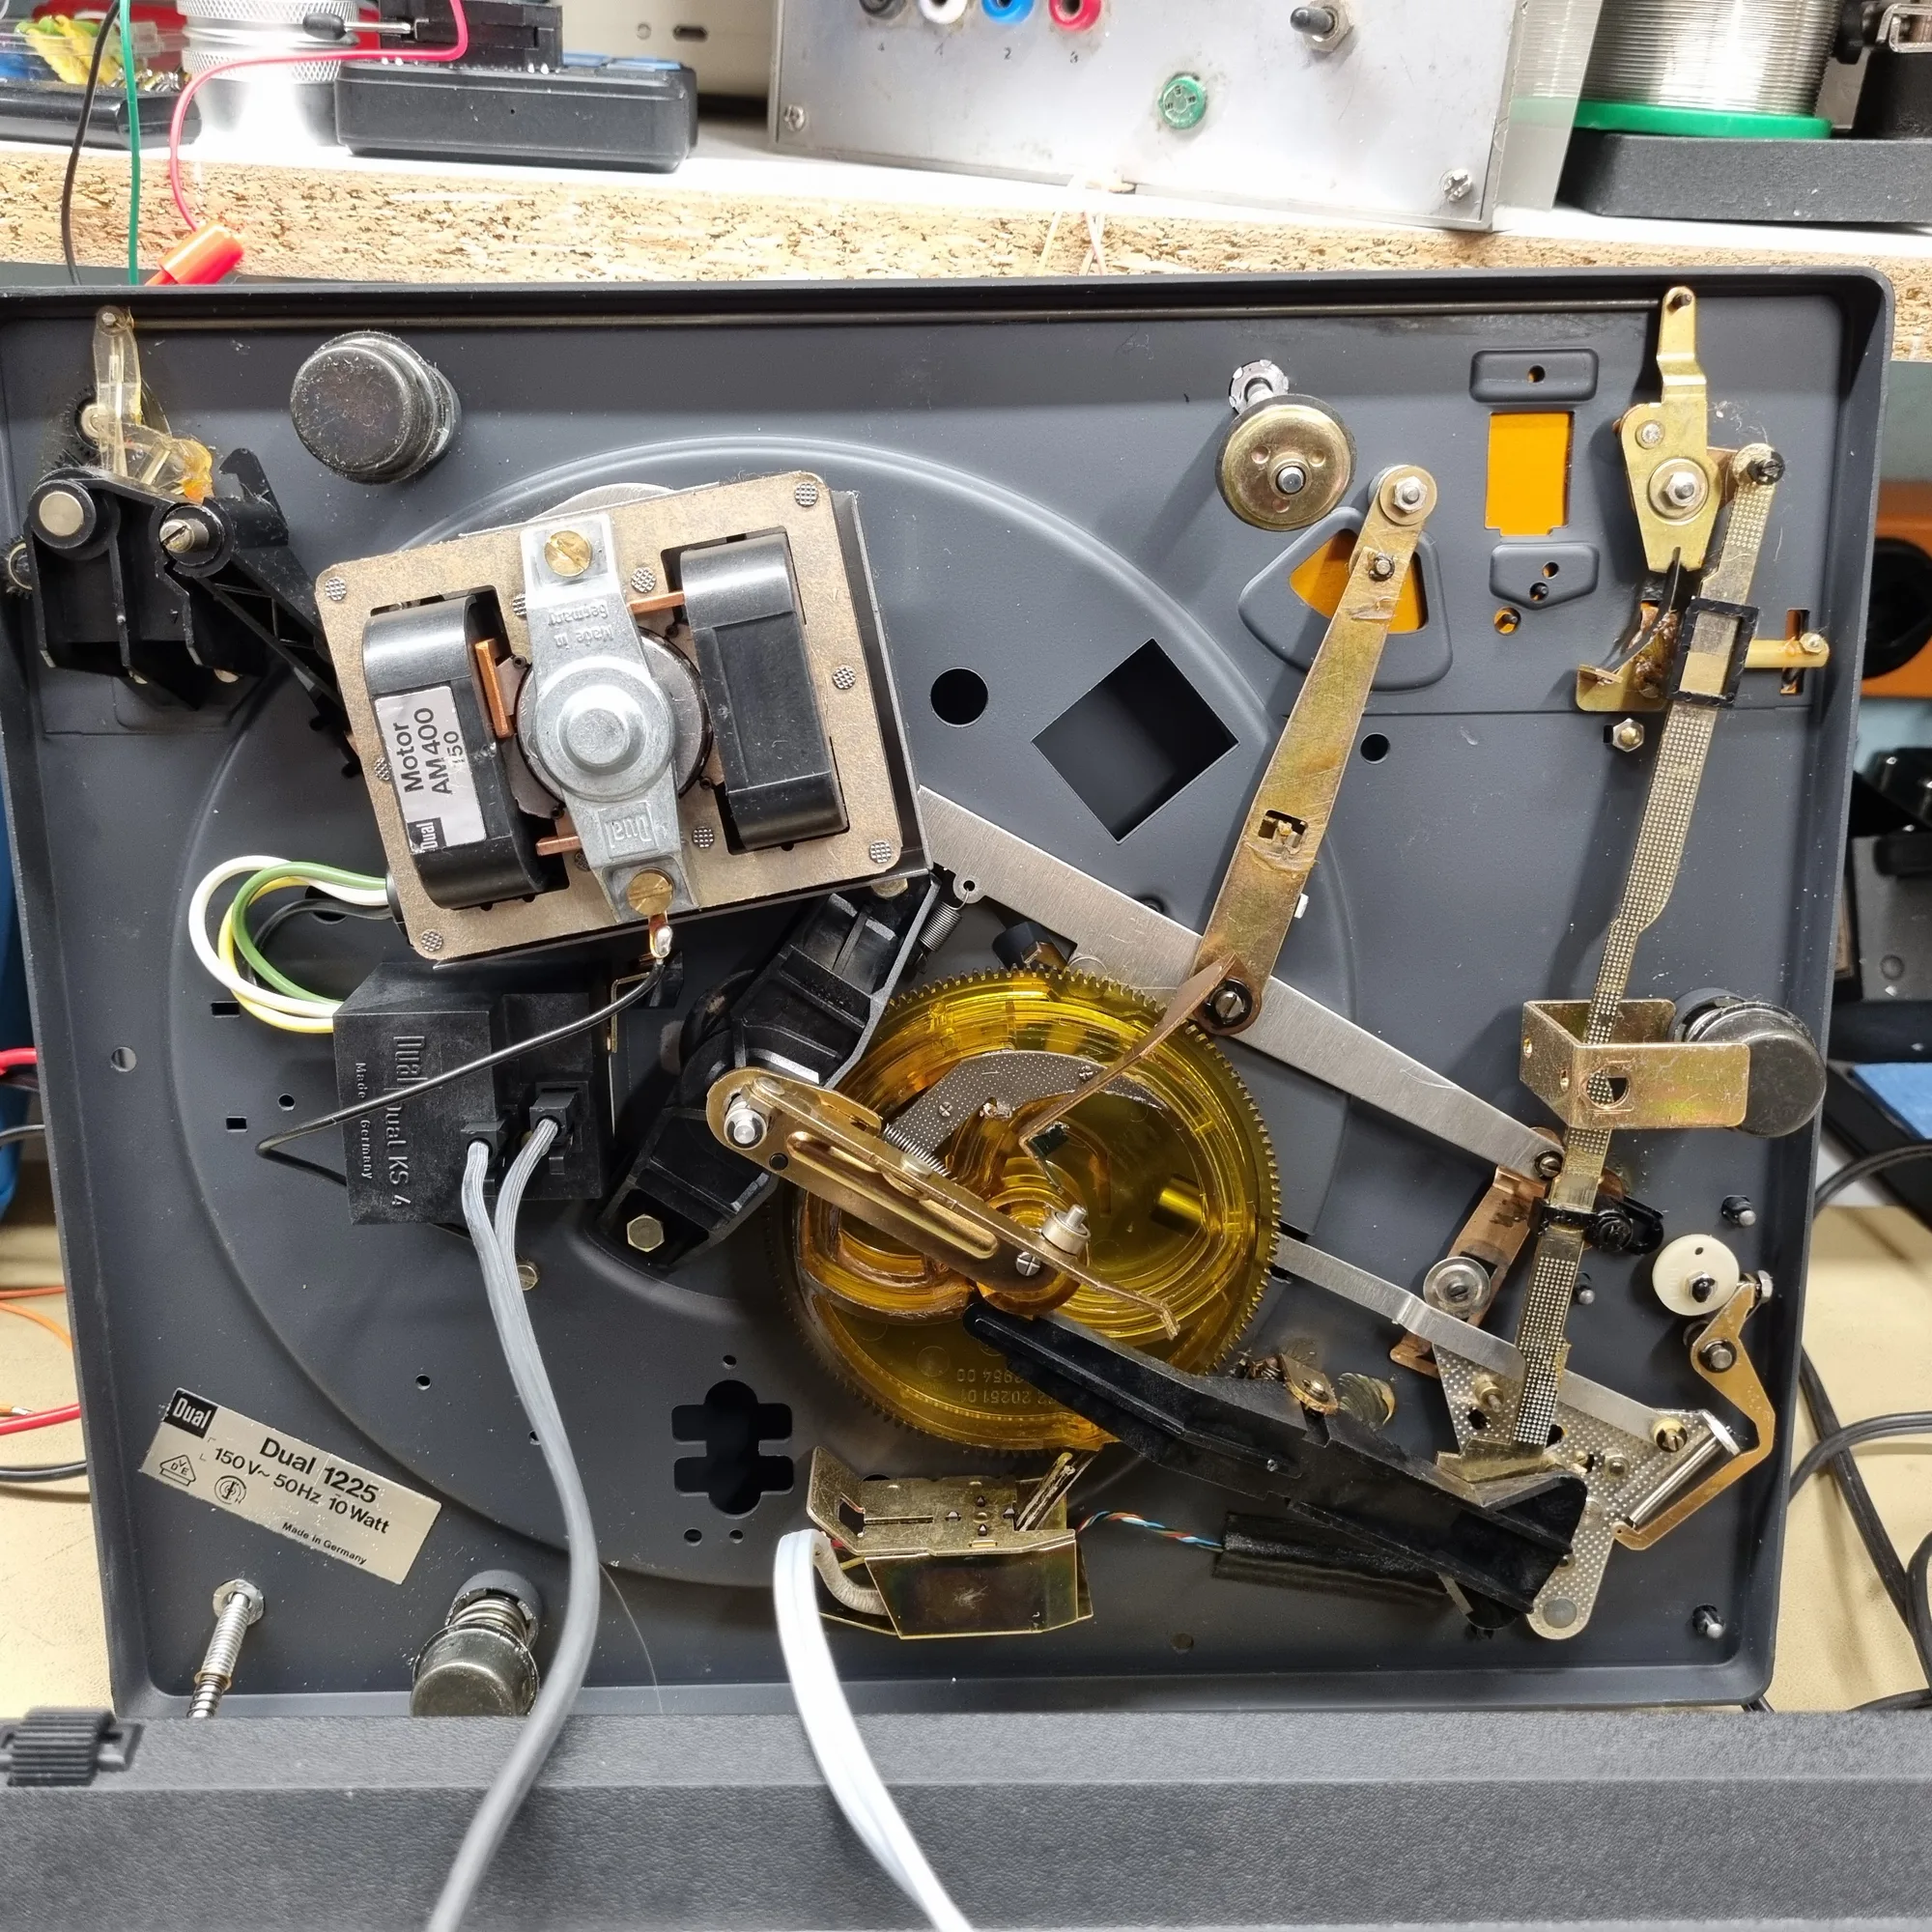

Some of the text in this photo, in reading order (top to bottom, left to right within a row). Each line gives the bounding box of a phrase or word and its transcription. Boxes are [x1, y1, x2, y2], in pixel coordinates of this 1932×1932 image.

[1003, 46, 1012, 60] 2
[392, 722, 425, 793] Motor
[415, 821, 440, 850] Dual
[605, 814, 653, 849] Dual
[393, 1035, 430, 1084] Dual
[355, 1063, 370, 1100] Made
[359, 1119, 375, 1180] Germany
[387, 1156, 411, 1186] KS
[391, 1194, 412, 1207] 4
[172, 1397, 213, 1430] Dual
[259, 1436, 380, 1504] Dual 1225
[282, 1521, 368, 1566] Made in Germany
